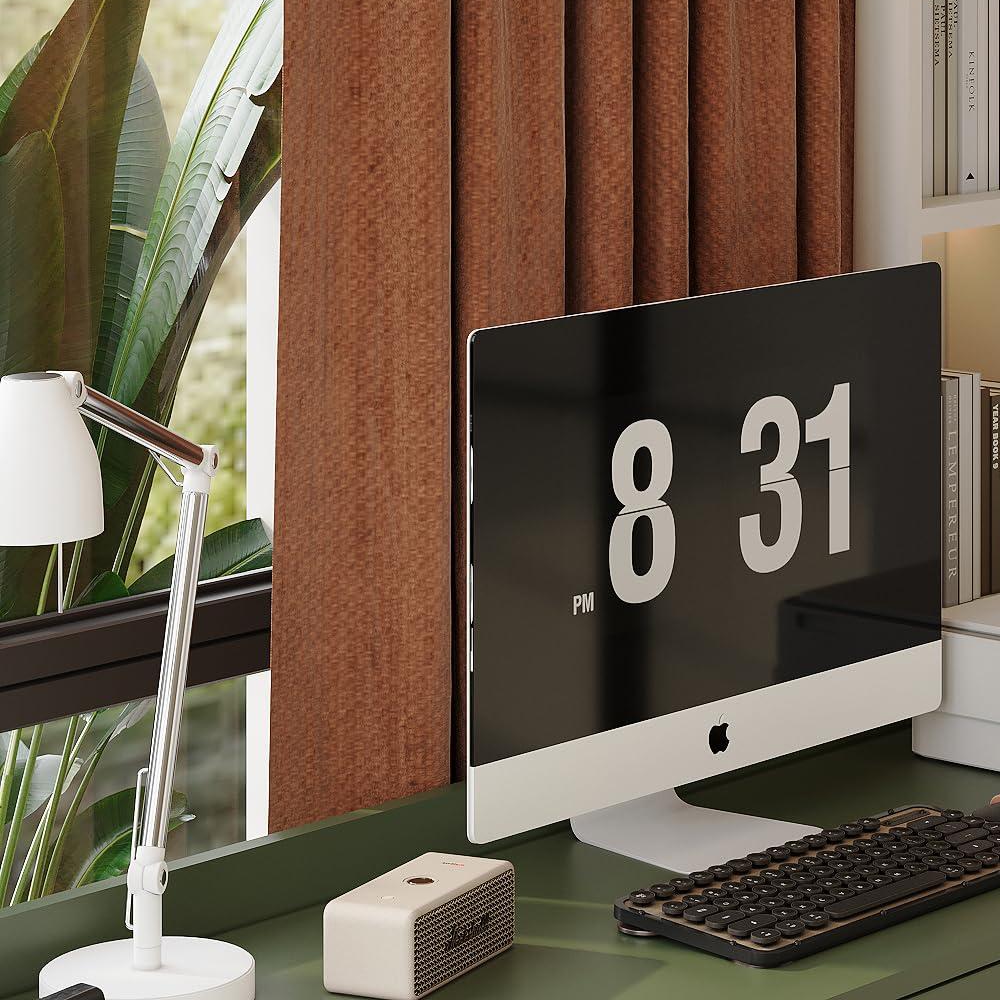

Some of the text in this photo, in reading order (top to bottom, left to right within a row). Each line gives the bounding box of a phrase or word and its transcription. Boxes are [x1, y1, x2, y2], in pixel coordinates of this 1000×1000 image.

[608, 382, 850, 604] 8 31
[572, 591, 595, 616] PM
